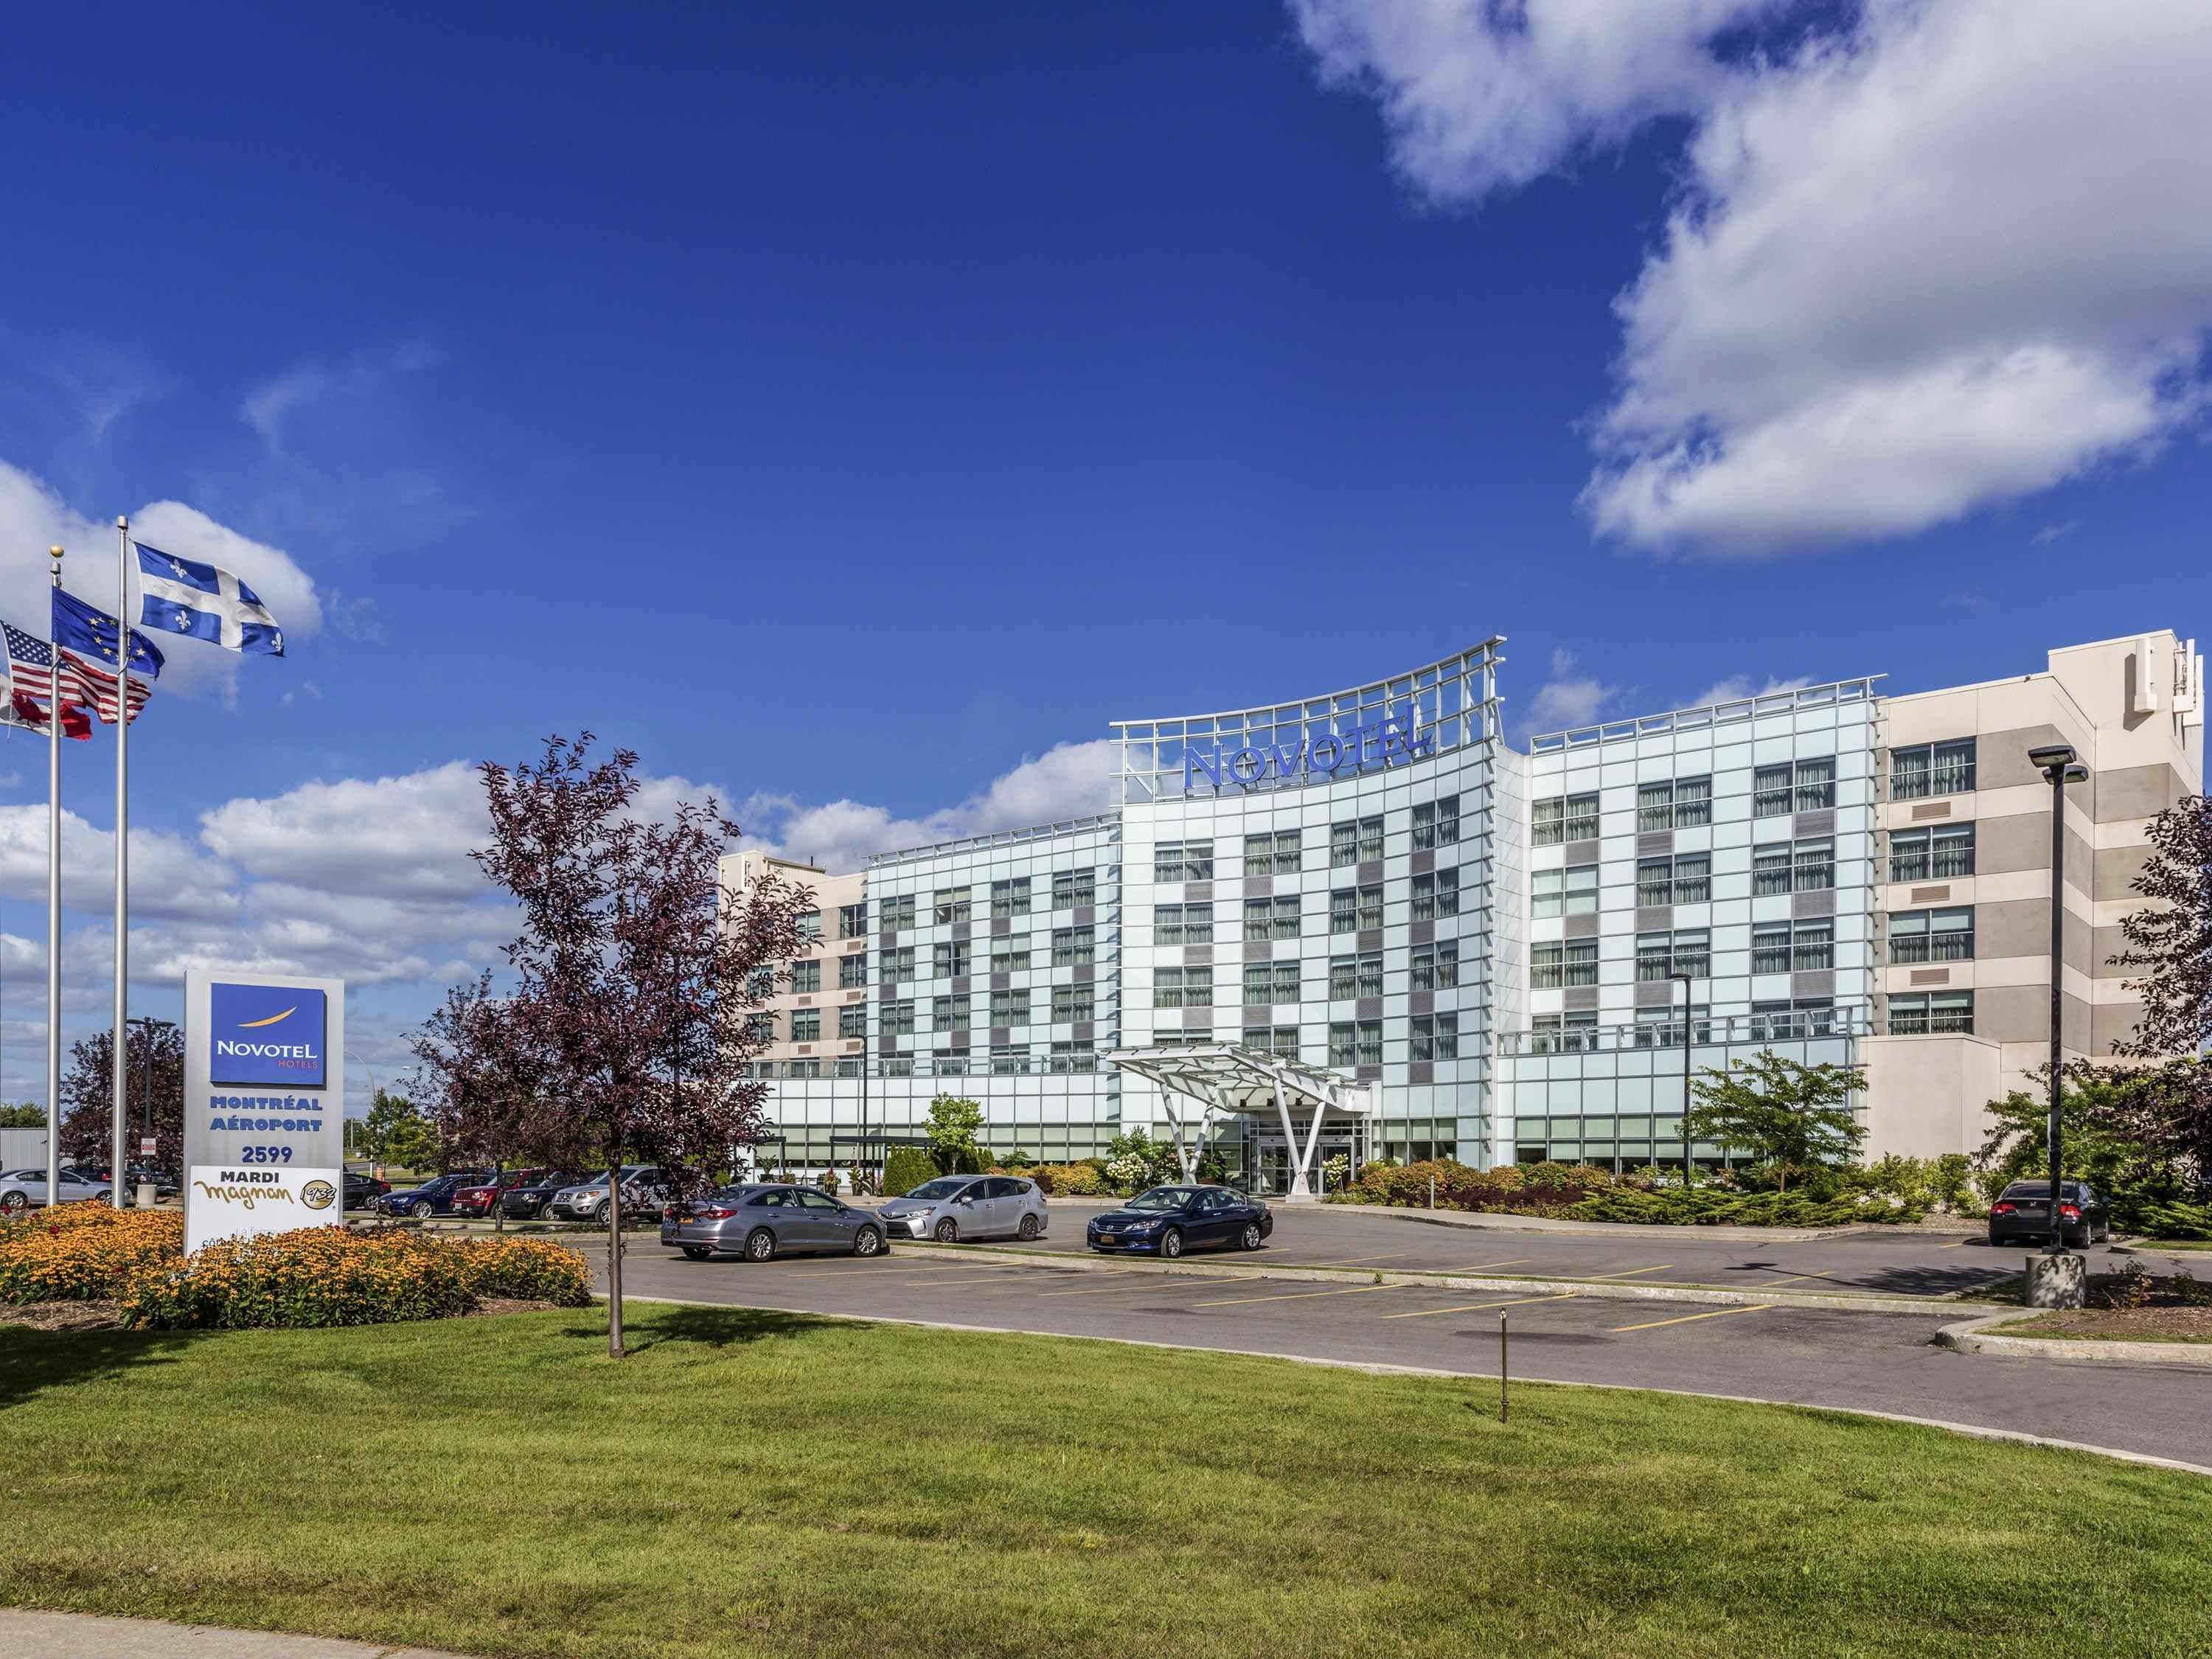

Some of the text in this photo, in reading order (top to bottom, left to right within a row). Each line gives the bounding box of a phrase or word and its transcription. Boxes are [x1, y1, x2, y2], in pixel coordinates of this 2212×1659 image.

[1183, 704, 1431, 788] NOVOTEL
[218, 1040, 318, 1059] NOVOTEL
[278, 1060, 319, 1068] HOTELS
[210, 1095, 323, 1111] MONTRÉAL
[209, 1115, 322, 1132] AÉROPORT
[242, 1146, 293, 1163] 2599
[220, 1171, 279, 1183] MARDI
[300, 1188, 337, 1200] 1932
